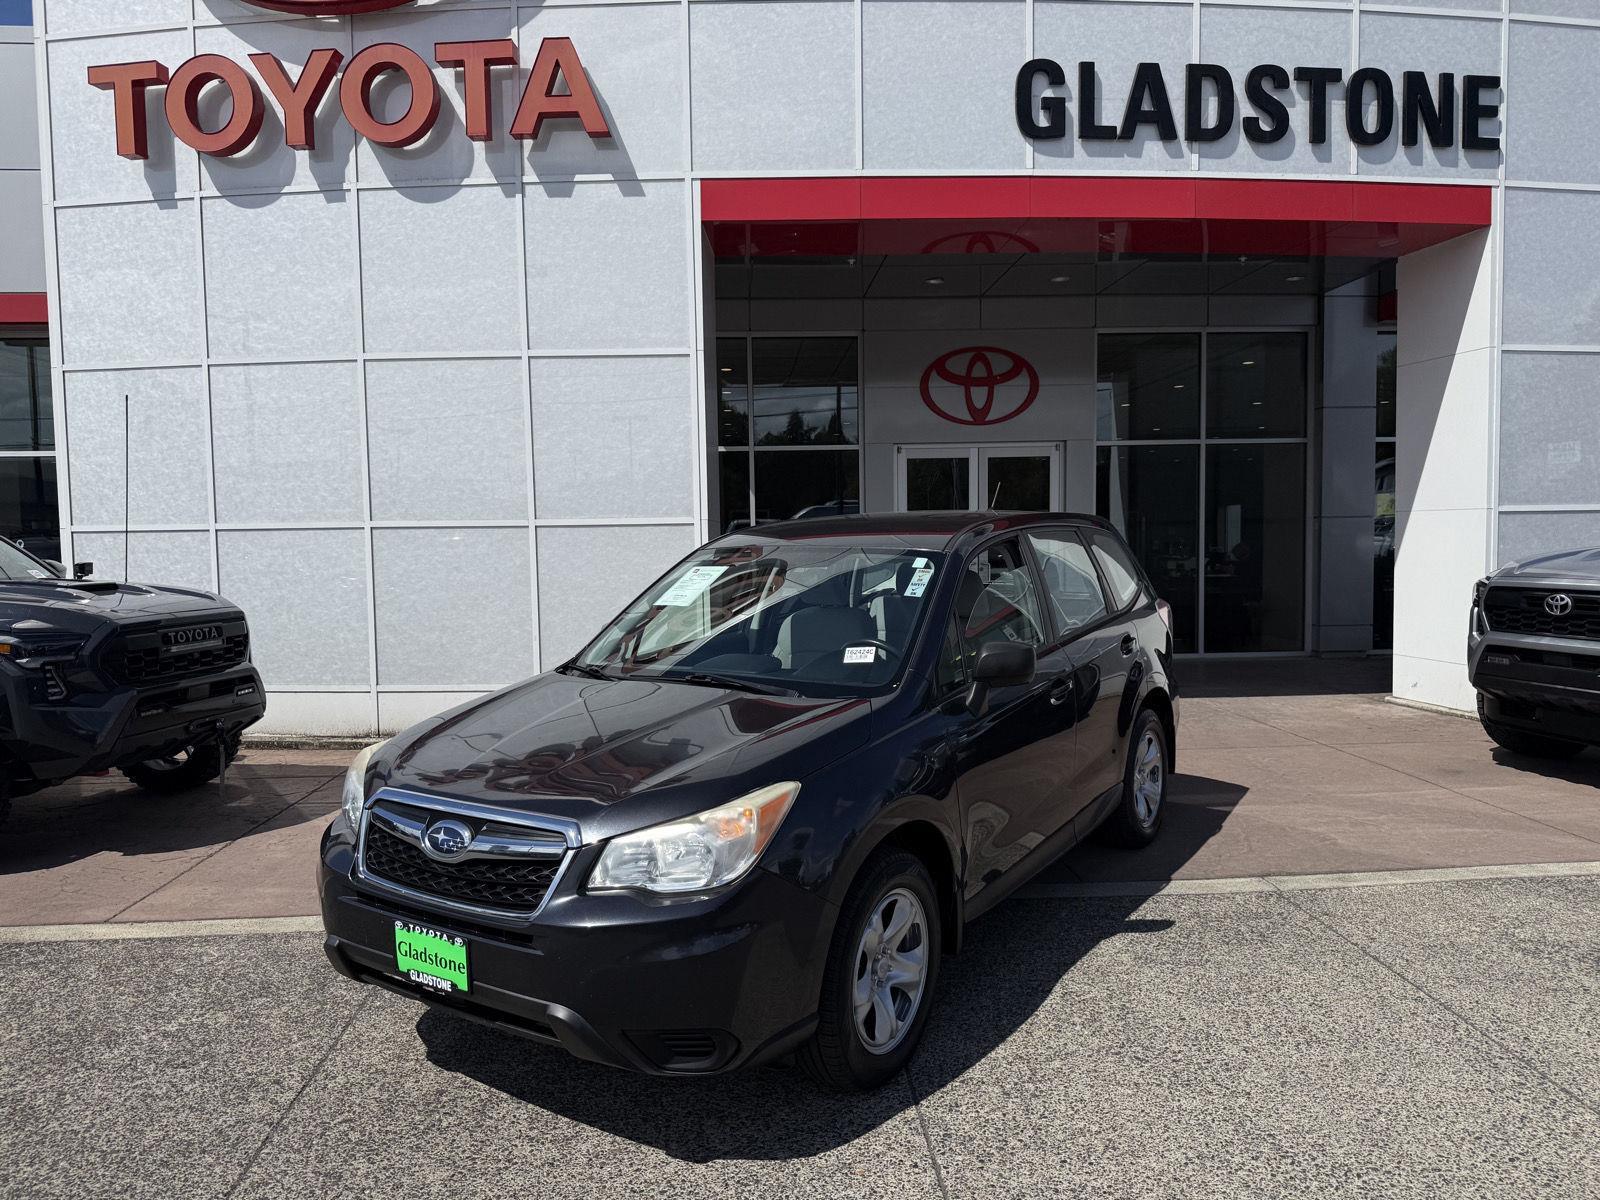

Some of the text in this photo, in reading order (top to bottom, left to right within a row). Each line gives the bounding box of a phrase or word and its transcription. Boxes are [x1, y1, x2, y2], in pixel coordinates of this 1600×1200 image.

[87, 37, 611, 160] TOYOTA
[1014, 58, 1501, 151] GLADSTONE
[168, 626, 219, 645] TOYOTA
[408, 924, 449, 942] TOYOTA
[397, 940, 466, 975] Gladstone
[409, 969, 452, 992] GLADSTONE
